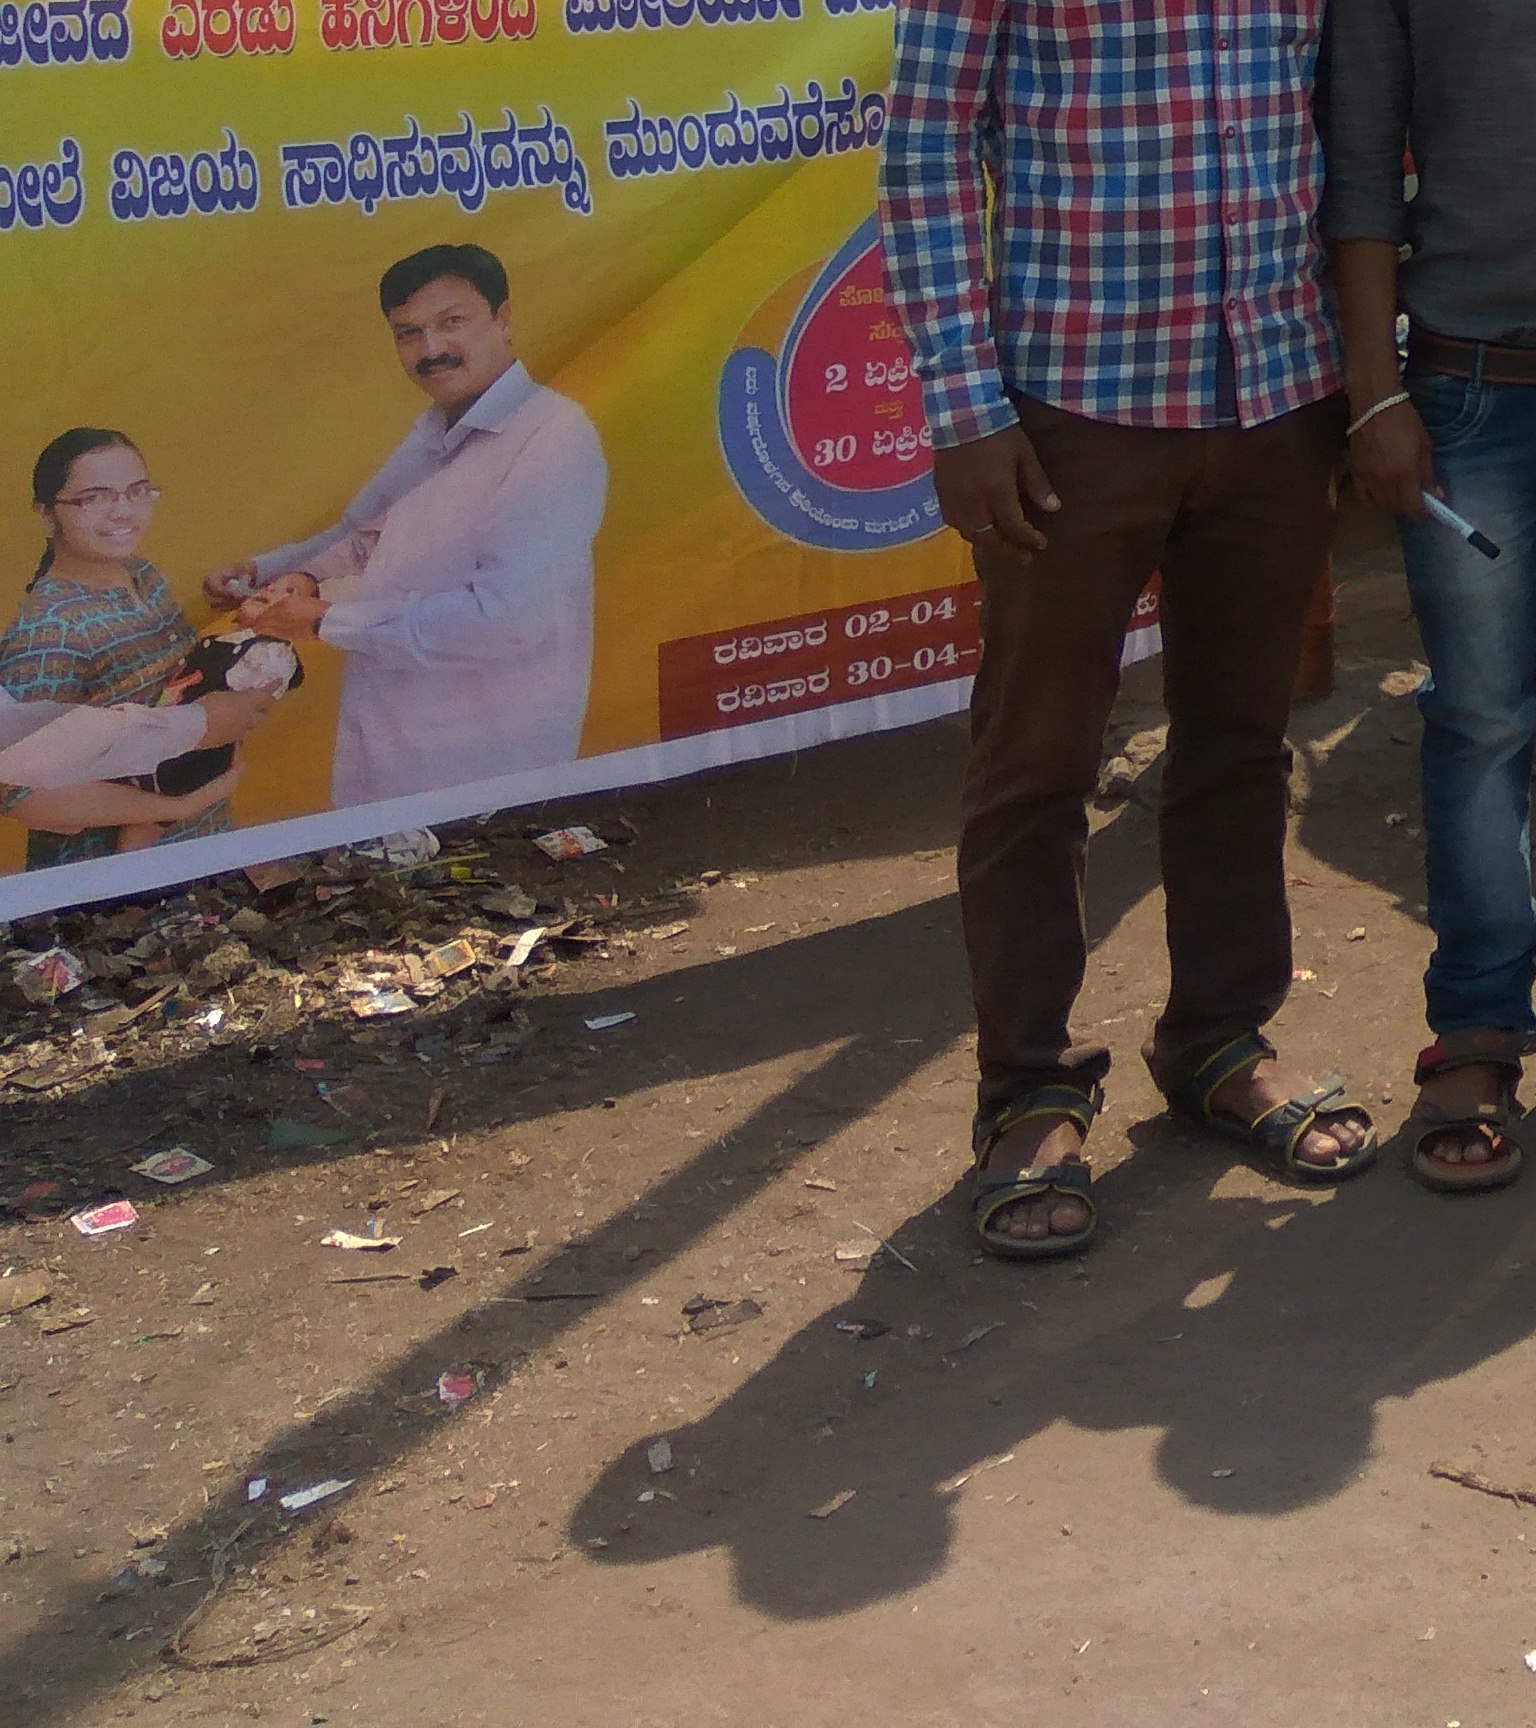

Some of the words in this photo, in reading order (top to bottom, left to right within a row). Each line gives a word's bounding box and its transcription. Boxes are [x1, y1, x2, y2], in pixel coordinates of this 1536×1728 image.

[109, 124, 260, 224] ವಿಜಯ
[280, 104, 594, 217] ಸಾಧಿಸುವುದನ್ನು
[825, 363, 848, 394] 2
[864, 356, 920, 392] ಏಪ್ರಿ
[813, 434, 858, 467] 30
[712, 619, 829, 665] ರವಿವಾರ
[843, 595, 958, 640] 02-04
[715, 667, 831, 715] ರವಿವಾರ
[846, 642, 985, 688] 30-04-
